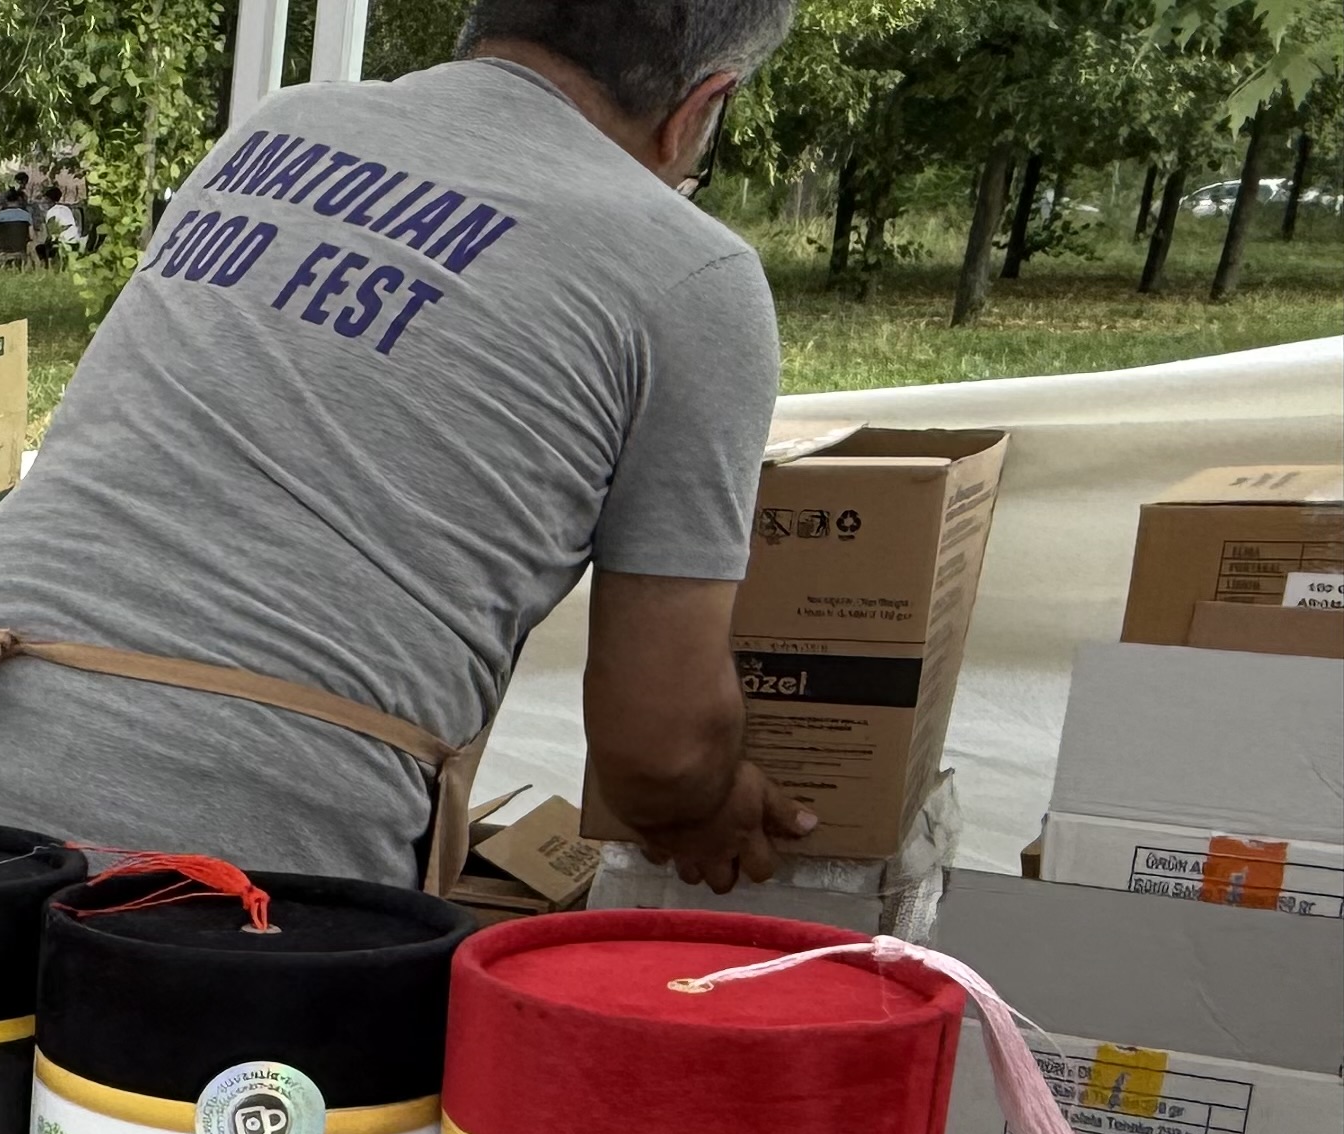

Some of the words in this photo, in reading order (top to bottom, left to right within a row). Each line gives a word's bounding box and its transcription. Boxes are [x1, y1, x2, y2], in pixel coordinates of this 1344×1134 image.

[204, 129, 515, 275] ANATOLIAN
[142, 209, 278, 289] FOOD
[270, 241, 445, 356] FEST
[742, 671, 808, 696] azel
